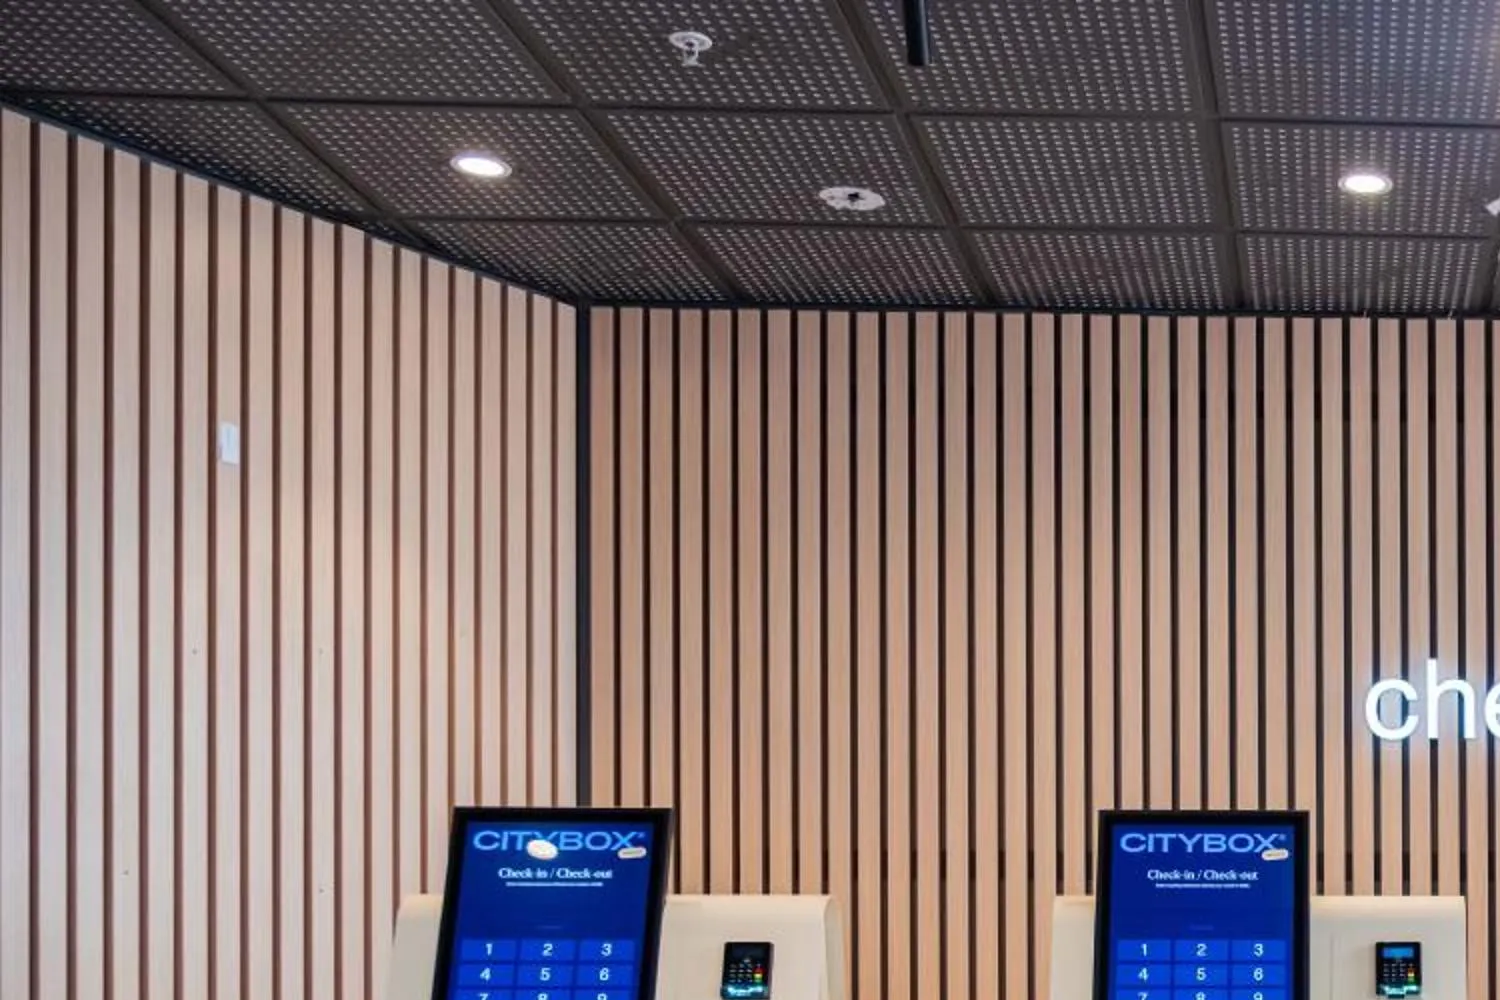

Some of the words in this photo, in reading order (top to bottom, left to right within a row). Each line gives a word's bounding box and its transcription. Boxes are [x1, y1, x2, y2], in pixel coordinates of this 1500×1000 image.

[485, 943, 493, 956] 1
[543, 943, 553, 956] 2
[601, 943, 612, 956] 3
[1141, 944, 1147, 956] 1
[1196, 943, 1207, 957] 2
[1254, 943, 1263, 957] 3
[480, 968, 491, 980] 4
[540, 968, 550, 981] 5
[600, 968, 609, 981] 6
[1138, 968, 1148, 981] 4
[1197, 968, 1206, 981] 5
[1253, 968, 1263, 981] 6
